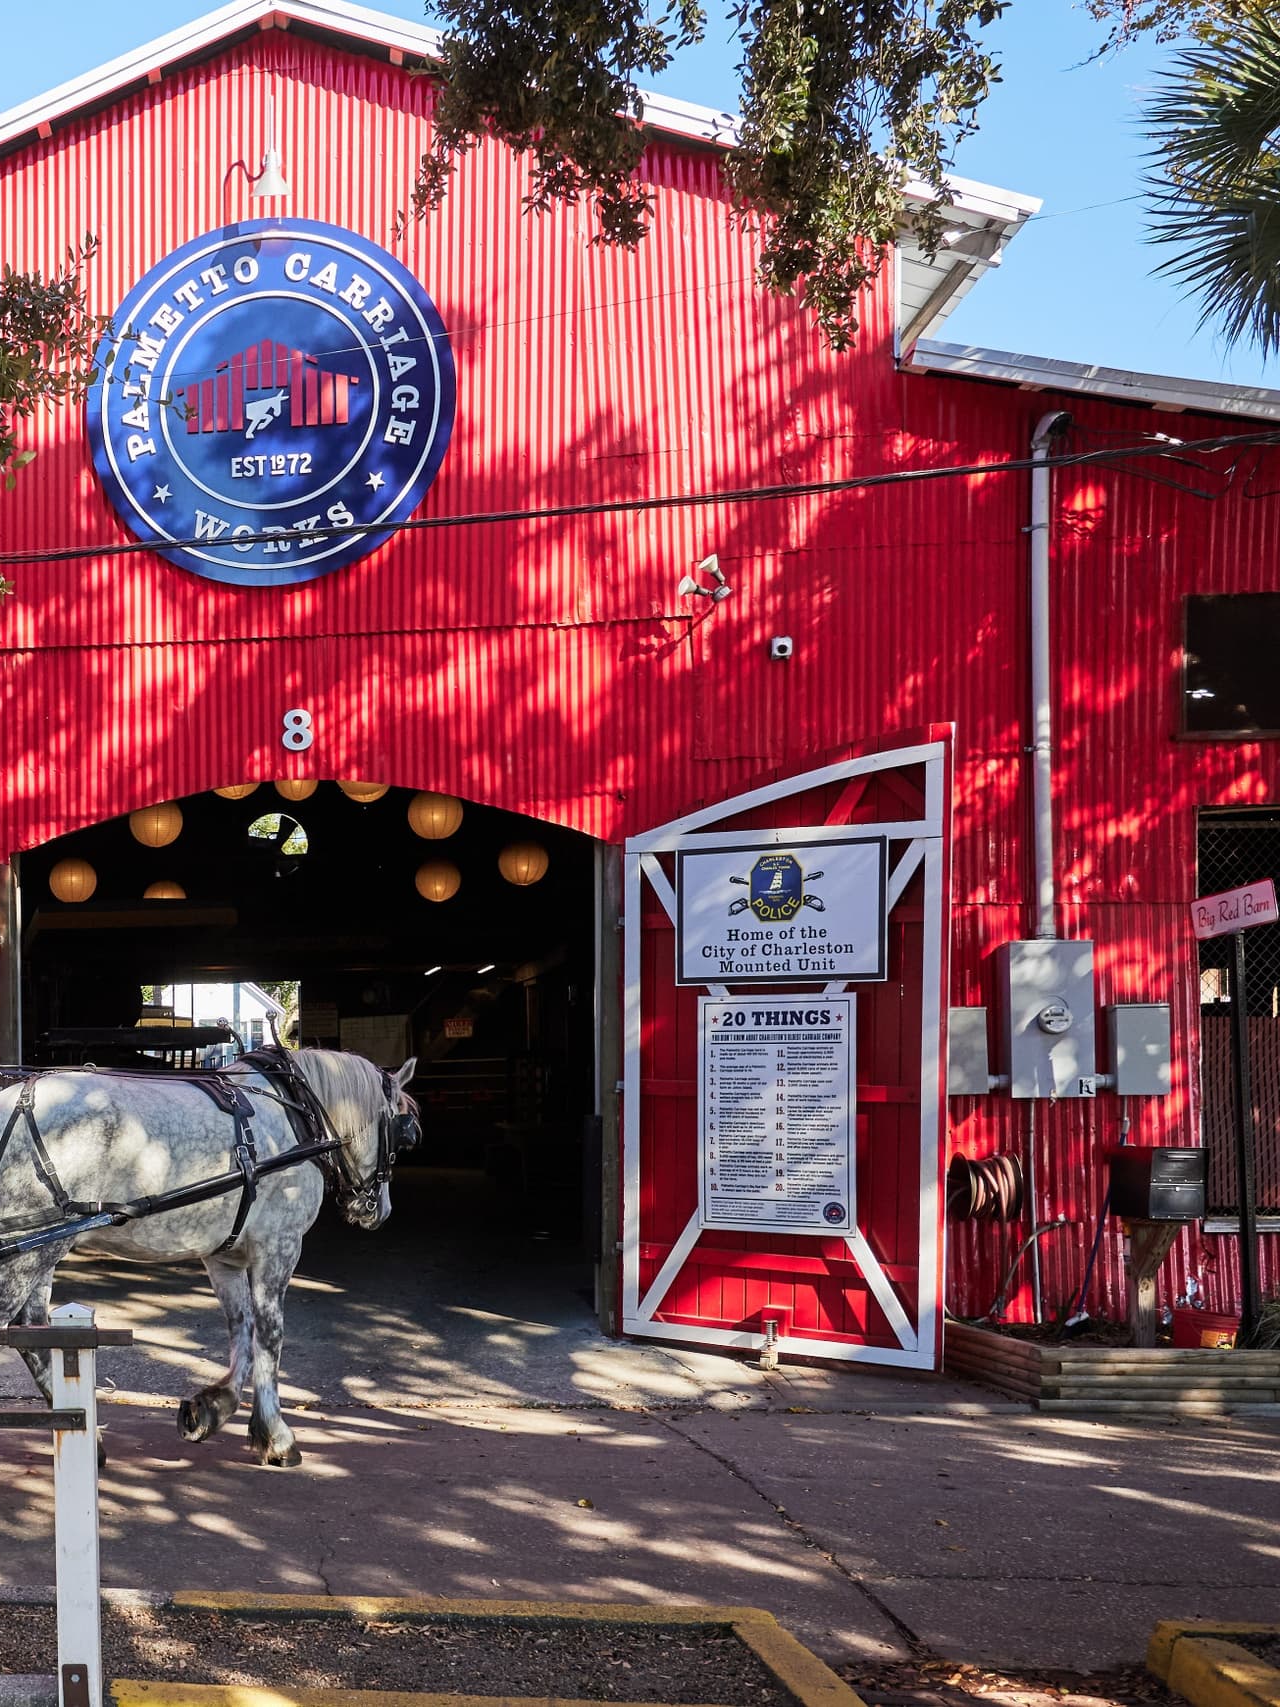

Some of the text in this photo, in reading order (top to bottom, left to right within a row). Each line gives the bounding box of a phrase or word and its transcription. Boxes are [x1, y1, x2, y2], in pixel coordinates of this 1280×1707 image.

[122, 252, 422, 462] PALMETTO CARRIAGE
[231, 452, 312, 478] EST 1972
[193, 501, 356, 555] WORKS
[282, 708, 314, 751] 8
[752, 896, 800, 919] POLICE
[1196, 893, 1270, 931] Big Red Barn
[727, 926, 827, 942] Home of the
[701, 942, 854, 960] City of Charleston
[719, 958, 836, 973] Mounted Unit
[722, 1010, 831, 1027] 20 THINGS
